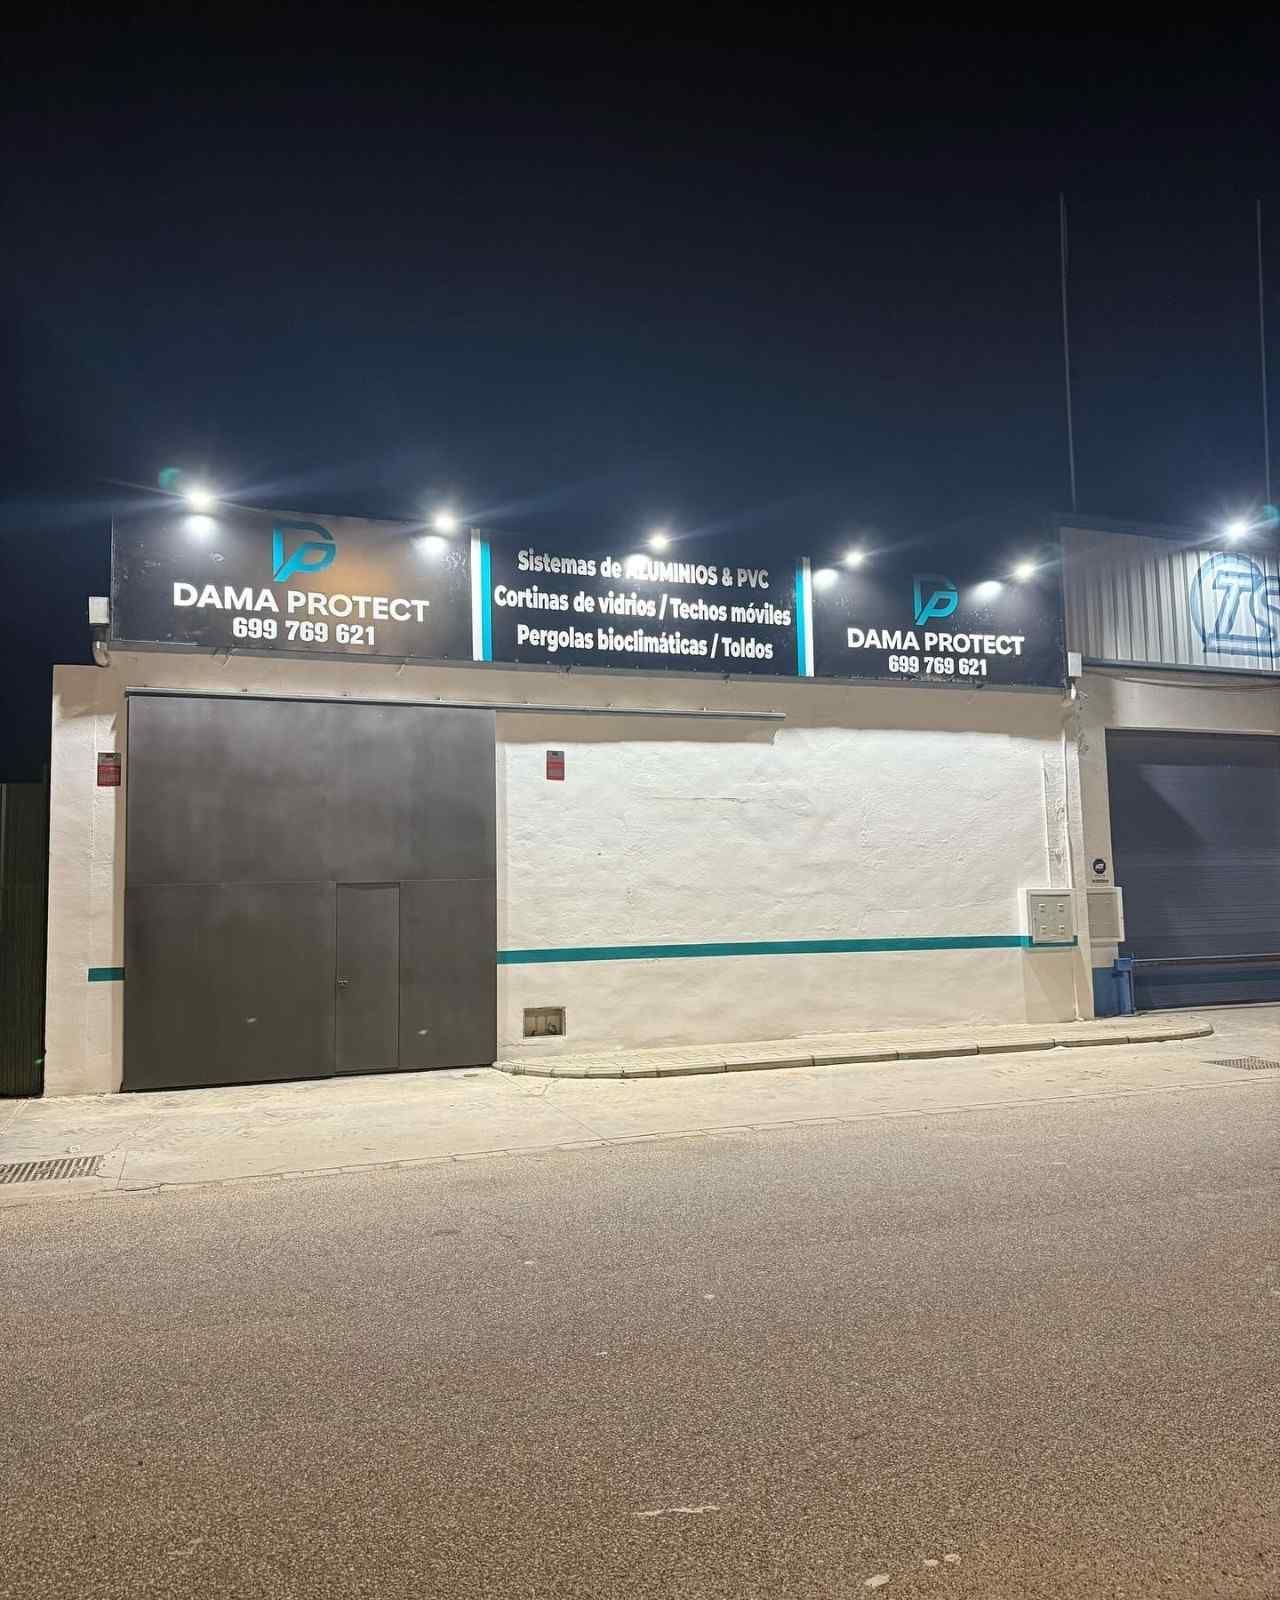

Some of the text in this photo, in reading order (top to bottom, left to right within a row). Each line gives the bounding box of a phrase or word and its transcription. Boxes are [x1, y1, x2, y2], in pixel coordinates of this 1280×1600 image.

[517, 549, 596, 577] Sistemas
[600, 556, 622, 578] de
[722, 567, 734, 587] &
[737, 568, 769, 589] PVC
[173, 582, 430, 622] DAMA PROTECT
[494, 585, 792, 626] Cortinas de vidrios / Techos móviles
[233, 617, 375, 645] 699 769 621
[517, 624, 774, 660] Pergolas bioclimáticas / Toldos
[847, 627, 1025, 656] DAMA PROTECT
[889, 655, 987, 676] 699 769 621
